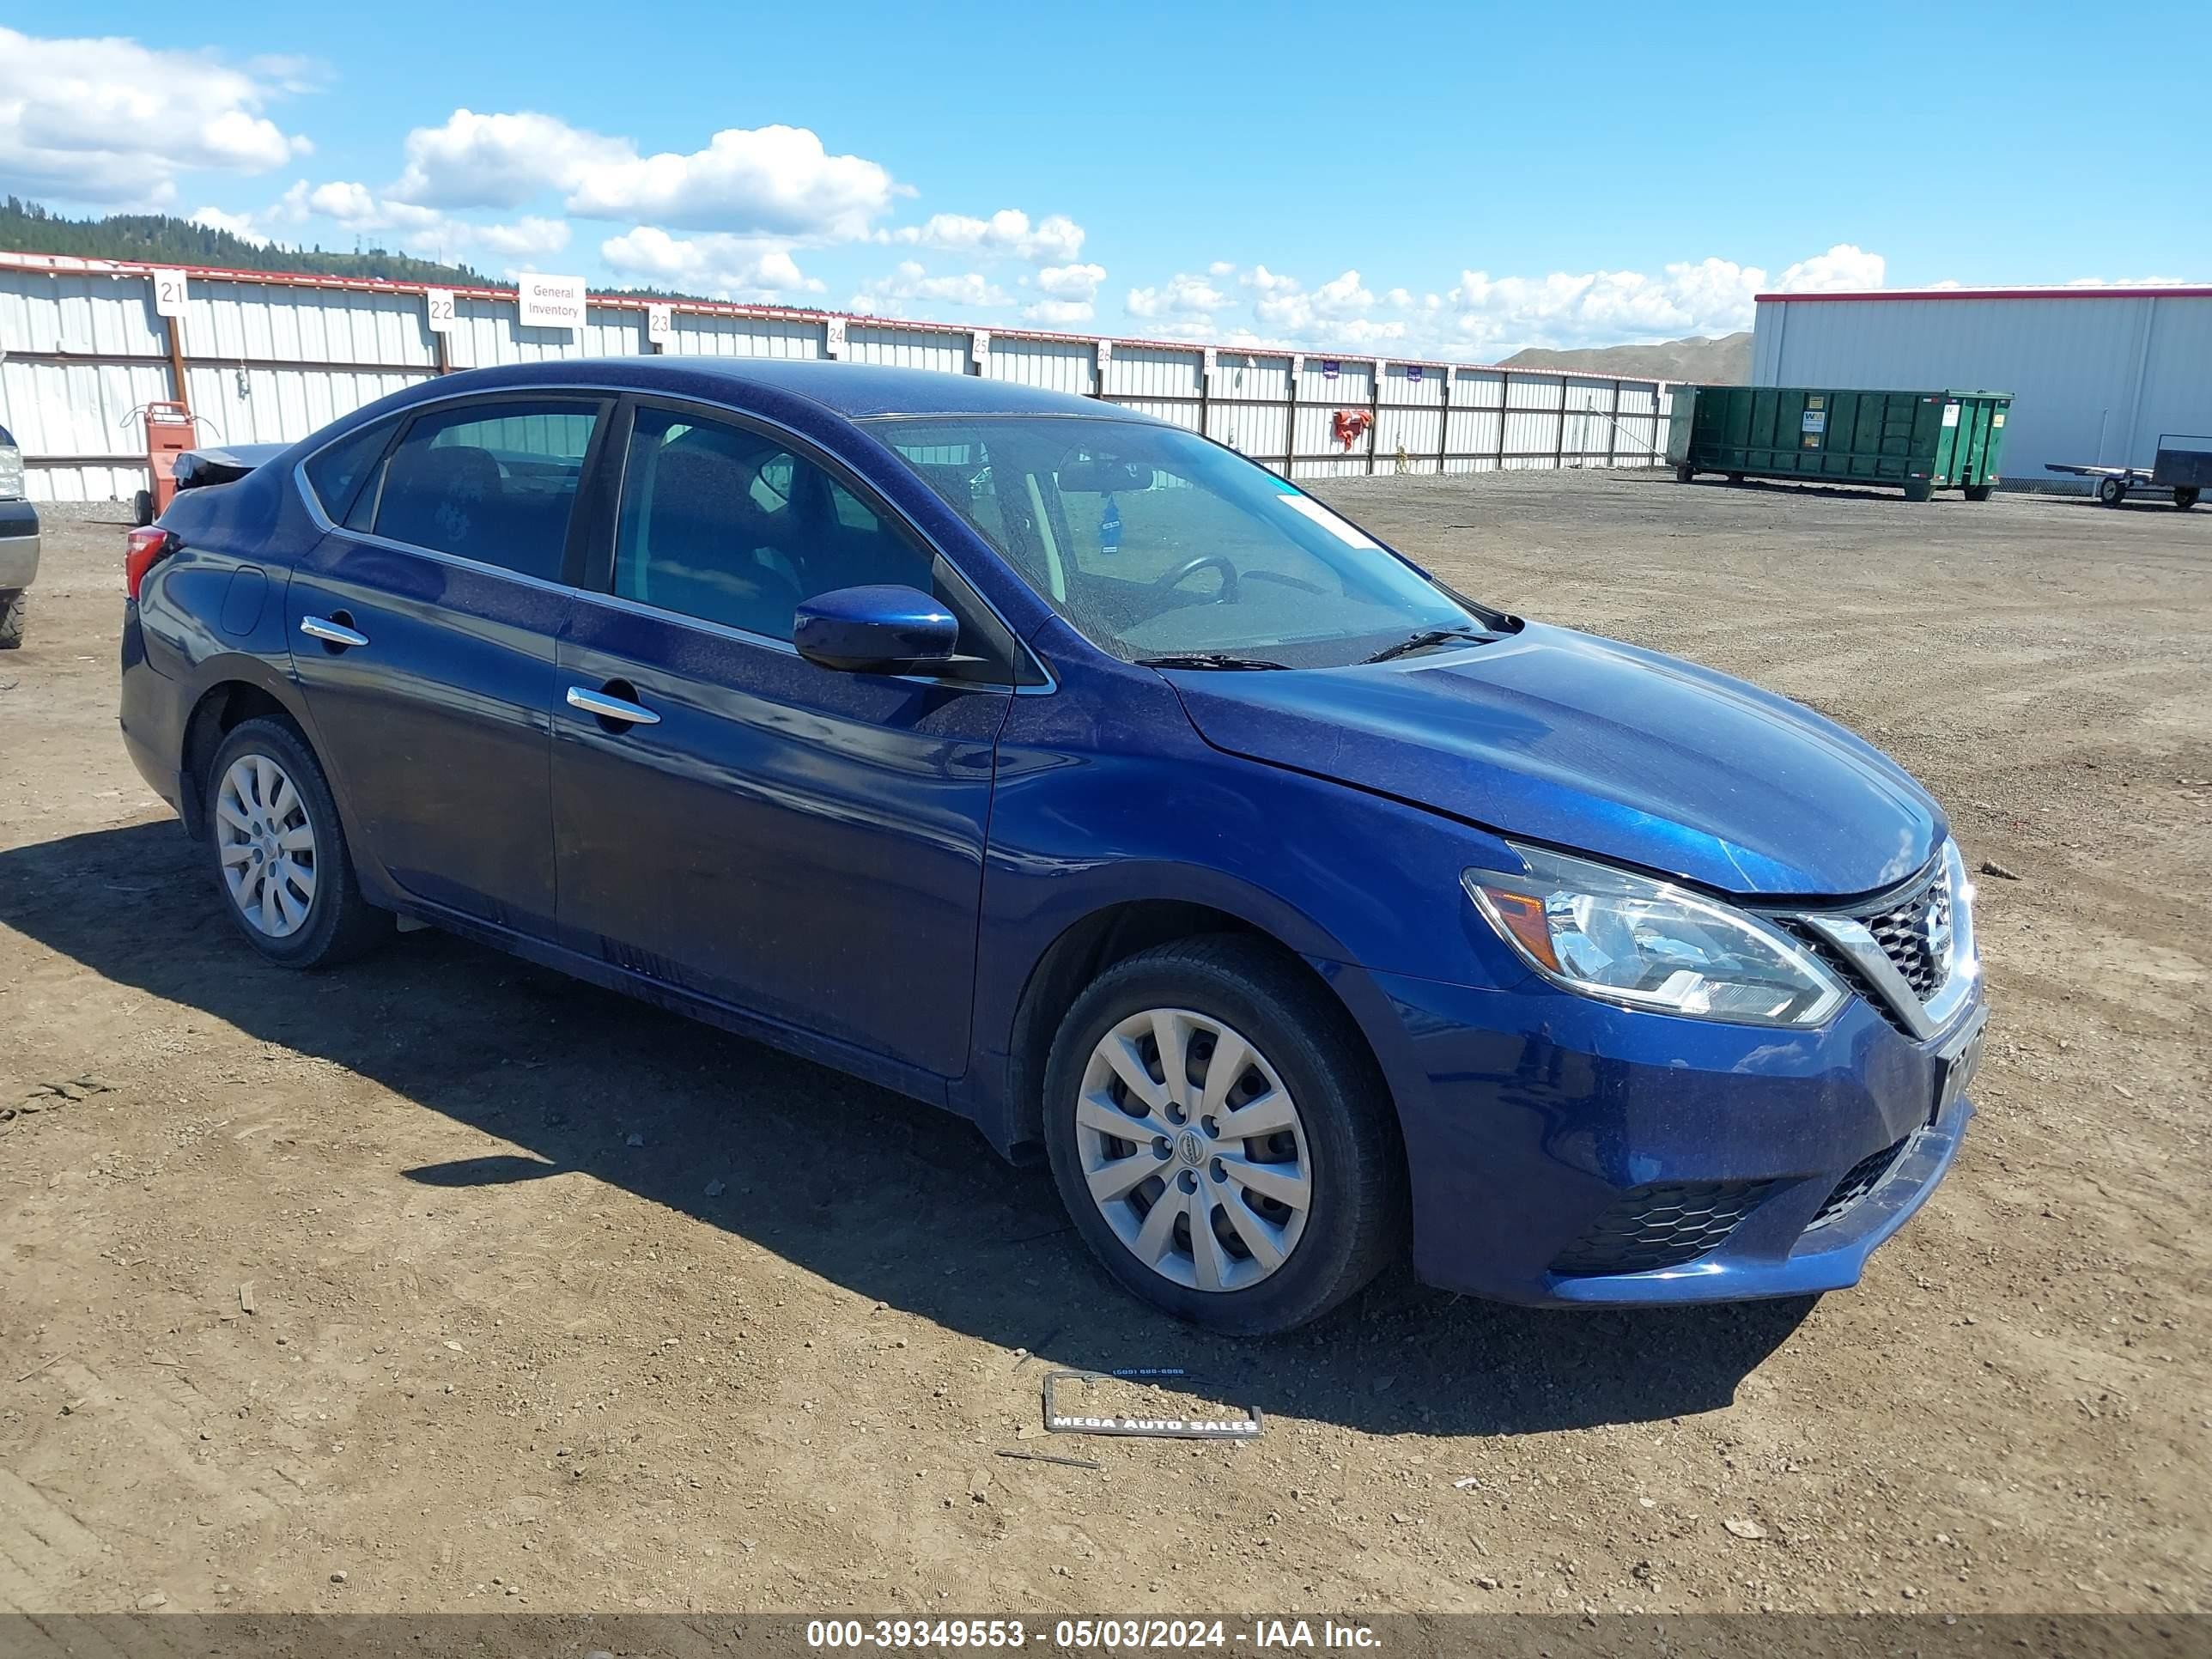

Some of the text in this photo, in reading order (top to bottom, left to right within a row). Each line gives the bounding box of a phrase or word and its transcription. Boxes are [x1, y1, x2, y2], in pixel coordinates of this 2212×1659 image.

[161, 283, 183, 303] 21
[533, 285, 574, 299] General
[431, 301, 453, 319] 22
[529, 302, 578, 318] Inventory
[652, 314, 668, 332] 23
[830, 327, 842, 343] 24
[975, 338, 987, 354] 25
[1098, 349, 1110, 362] 26
[1205, 356, 1216, 368] 27
[1053, 1417, 1258, 1431] MEGA AUTO SALES
